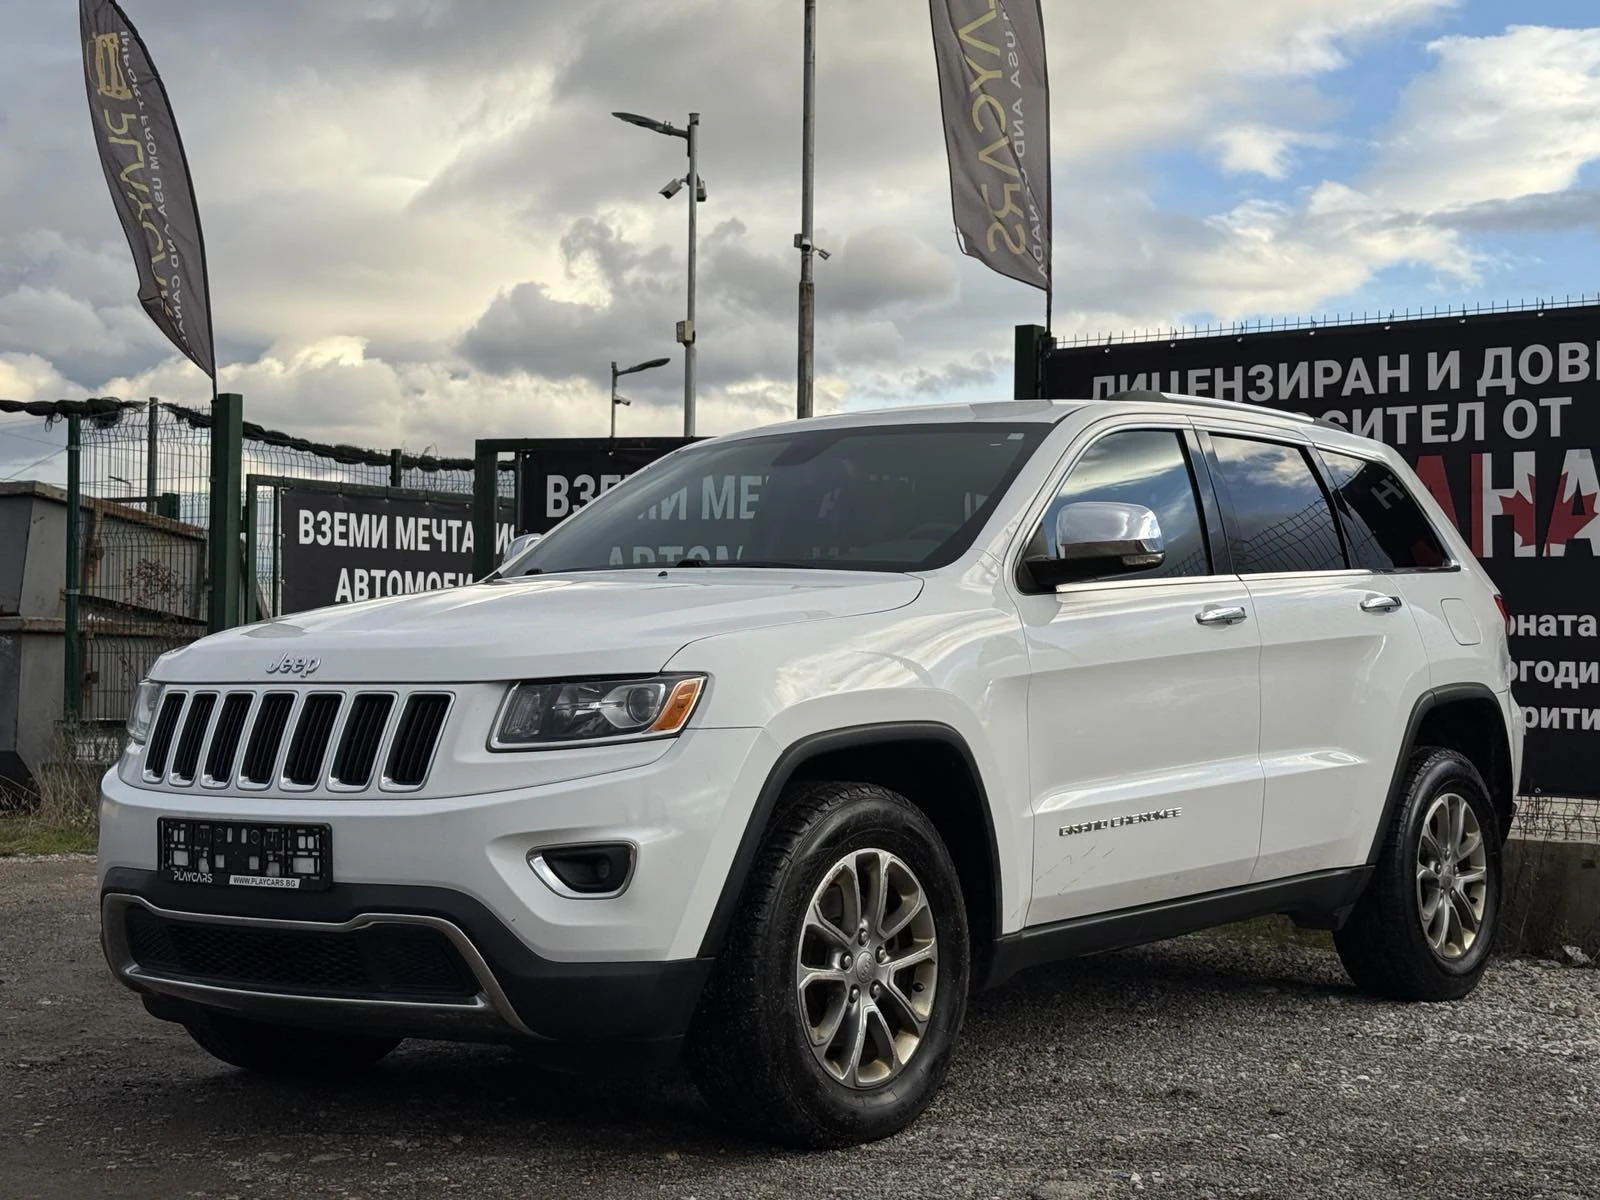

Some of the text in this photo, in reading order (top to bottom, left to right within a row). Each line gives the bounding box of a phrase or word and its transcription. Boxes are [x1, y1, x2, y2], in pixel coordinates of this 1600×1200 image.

[1427, 350, 1460, 391] И
[1477, 339, 1600, 397] ДОВ
[1502, 397, 1573, 440] ОТ
[299, 509, 515, 555] ВЗЕМИ МЕЧТАИ
[264, 652, 322, 679] Jeep
[173, 870, 213, 883] PLAYCARS
[232, 876, 297, 888] WWW.PLAYCARS.BG
